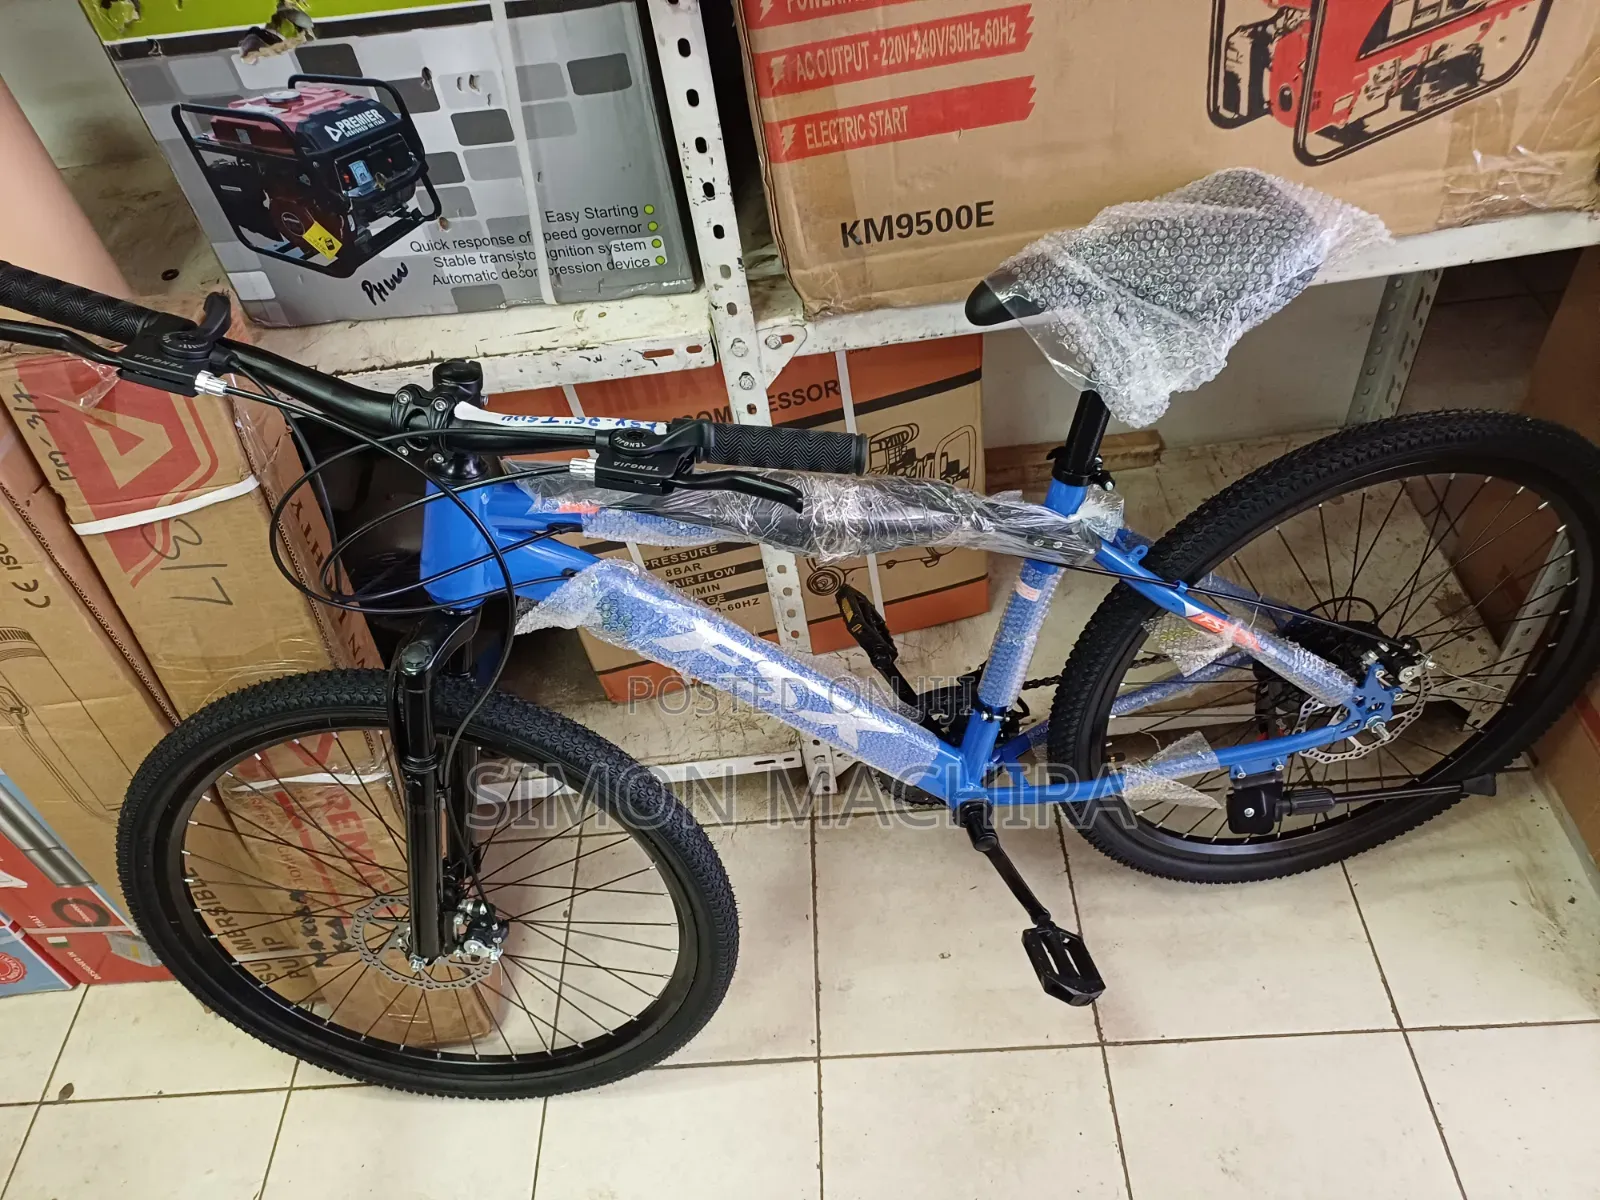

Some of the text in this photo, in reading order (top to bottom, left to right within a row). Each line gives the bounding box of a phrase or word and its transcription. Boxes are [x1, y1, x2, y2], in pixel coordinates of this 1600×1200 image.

[796, 54, 815, 83] AC
[818, 41, 870, 78] OUTPUT
[335, 109, 382, 133] PREMIER
[804, 105, 909, 150] ELECTRIC START
[545, 204, 639, 223] Easy Starting
[840, 200, 995, 249] KM9500E
[410, 223, 643, 253] Quick response of peed governor
[433, 240, 647, 268] Stable transisto ignition system
[432, 269, 499, 285] Automatic
[606, 257, 651, 270] device
[644, 544, 719, 568] PRESSURE
[665, 563, 703, 577] 8BAR
[697, 566, 737, 583] FLOW
